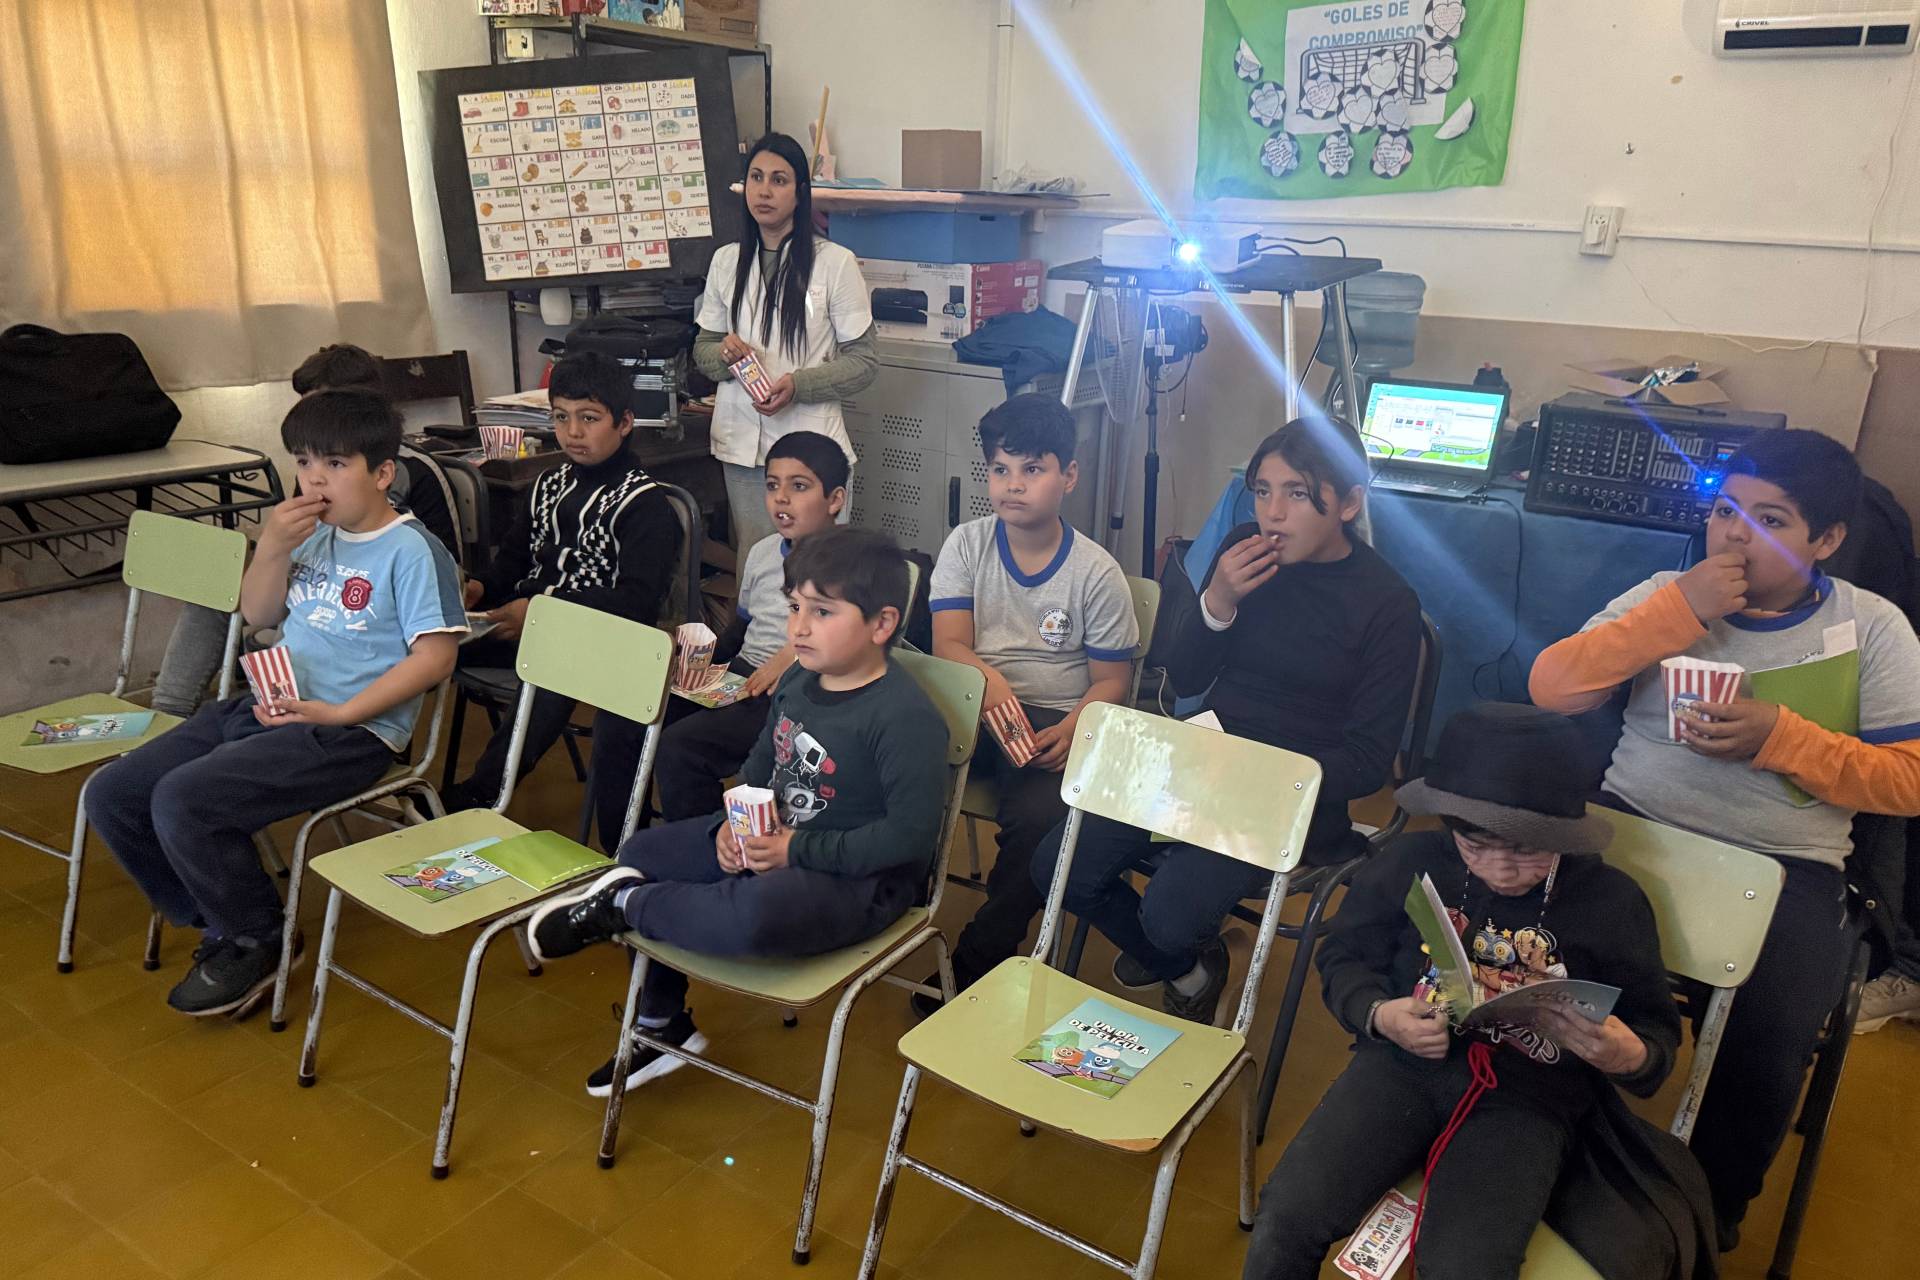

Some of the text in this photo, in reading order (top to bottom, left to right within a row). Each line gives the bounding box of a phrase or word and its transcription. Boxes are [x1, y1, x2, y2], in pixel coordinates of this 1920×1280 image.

[1388, 1, 1409, 18] DE
[348, 585, 364, 605] 8
[1068, 1019, 1087, 1031] DE
[1093, 1020, 1115, 1034] UN
